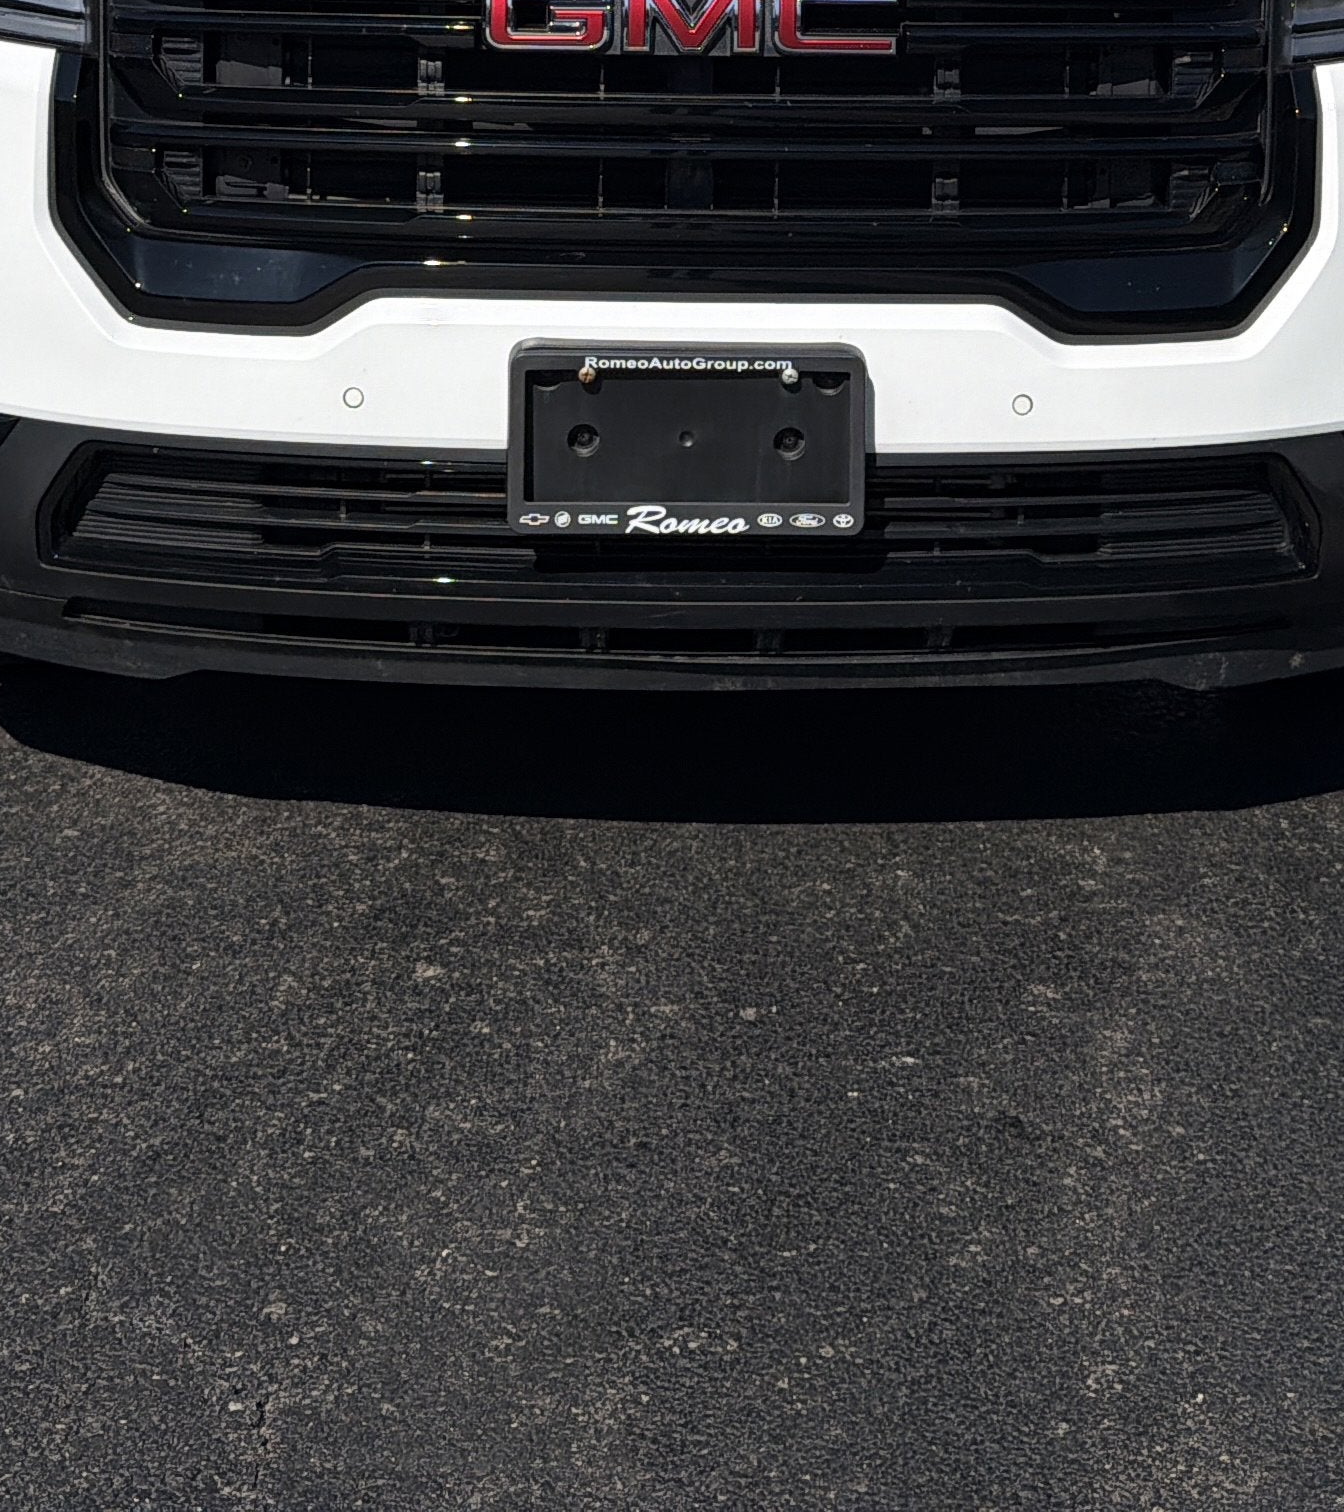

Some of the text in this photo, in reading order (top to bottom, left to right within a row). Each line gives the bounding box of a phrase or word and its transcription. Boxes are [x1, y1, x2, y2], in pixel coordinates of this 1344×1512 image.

[584, 356, 793, 372] RomeoAutoGroup.com
[578, 514, 618, 525] GMC
[625, 505, 750, 534] Romeo
